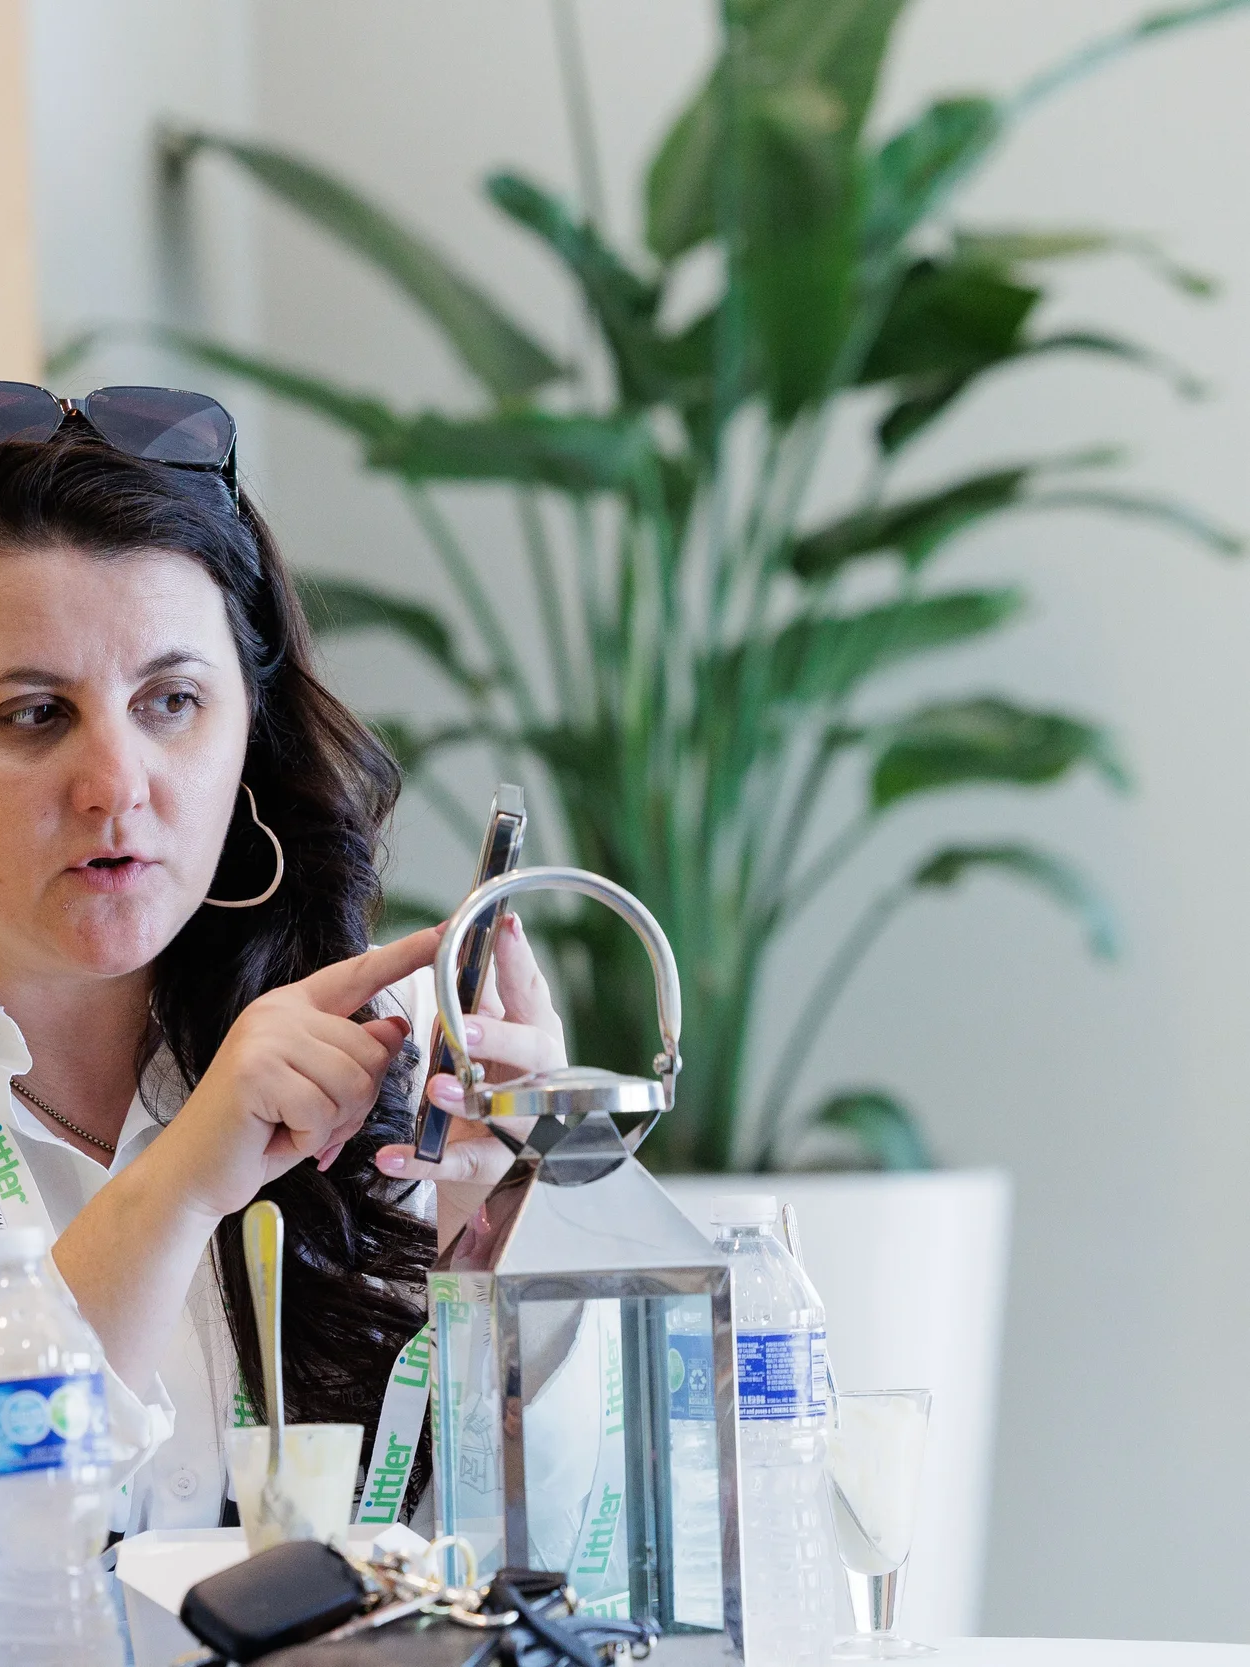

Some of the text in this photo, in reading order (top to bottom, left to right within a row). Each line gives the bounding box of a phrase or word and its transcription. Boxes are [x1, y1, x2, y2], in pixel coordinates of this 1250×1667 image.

[394, 1322, 429, 1388] Litt
[606, 1330, 624, 1436] Littler
[361, 1434, 412, 1523] Littler
[577, 1483, 622, 1573] Littler
